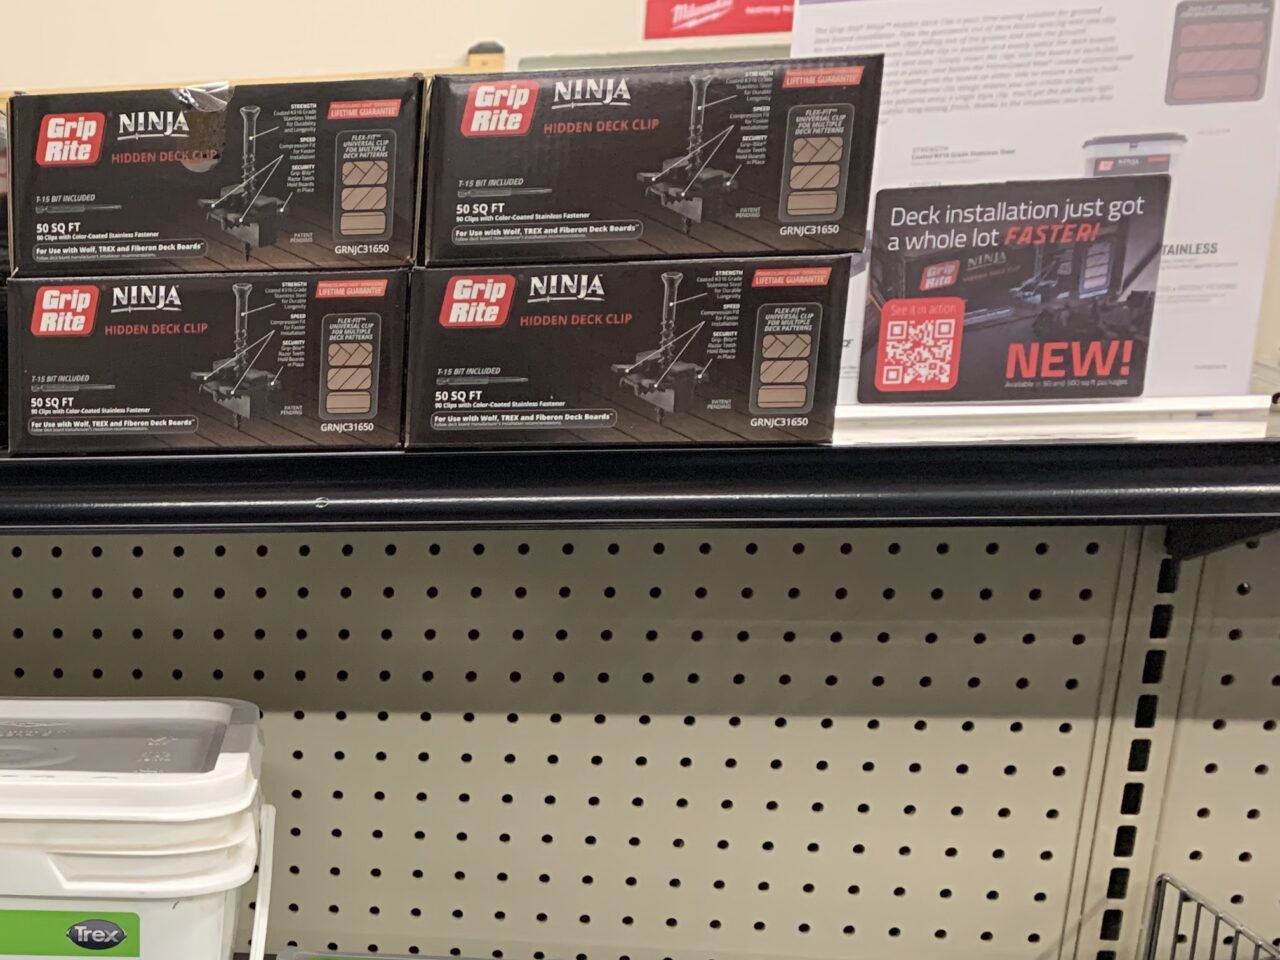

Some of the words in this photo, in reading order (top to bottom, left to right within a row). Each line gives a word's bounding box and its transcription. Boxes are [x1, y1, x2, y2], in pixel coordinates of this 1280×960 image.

[554, 78, 631, 103] NINJA
[47, 115, 96, 142] Grip
[118, 110, 189, 134] NINJA
[45, 138, 91, 163] Rite
[890, 205, 940, 227] Deck
[945, 201, 1059, 225] installation
[1061, 199, 1104, 224] just
[1107, 196, 1145, 221] got
[887, 234, 900, 251] a
[905, 229, 967, 250] whole
[972, 227, 999, 247] lot
[1004, 223, 1100, 246] FASTER!
[529, 274, 604, 298] NINJA
[1006, 339, 1133, 379] NEW!
[750, 416, 808, 428] GRNJC31650
[75, 926, 120, 943] Trex
